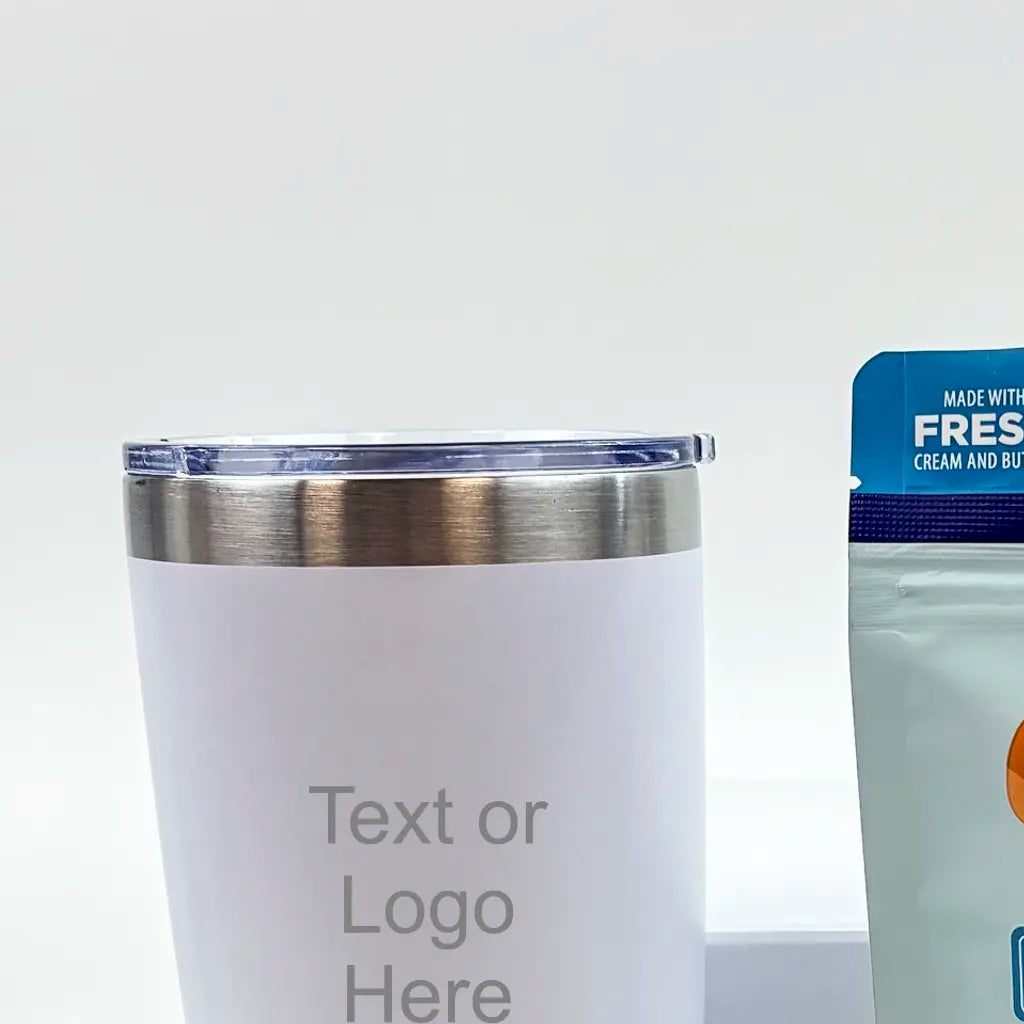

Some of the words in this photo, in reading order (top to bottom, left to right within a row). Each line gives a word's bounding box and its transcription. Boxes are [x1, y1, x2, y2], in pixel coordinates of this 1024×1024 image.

[944, 390, 985, 408] MADE
[914, 451, 963, 470] CREAM
[967, 451, 998, 469] AND
